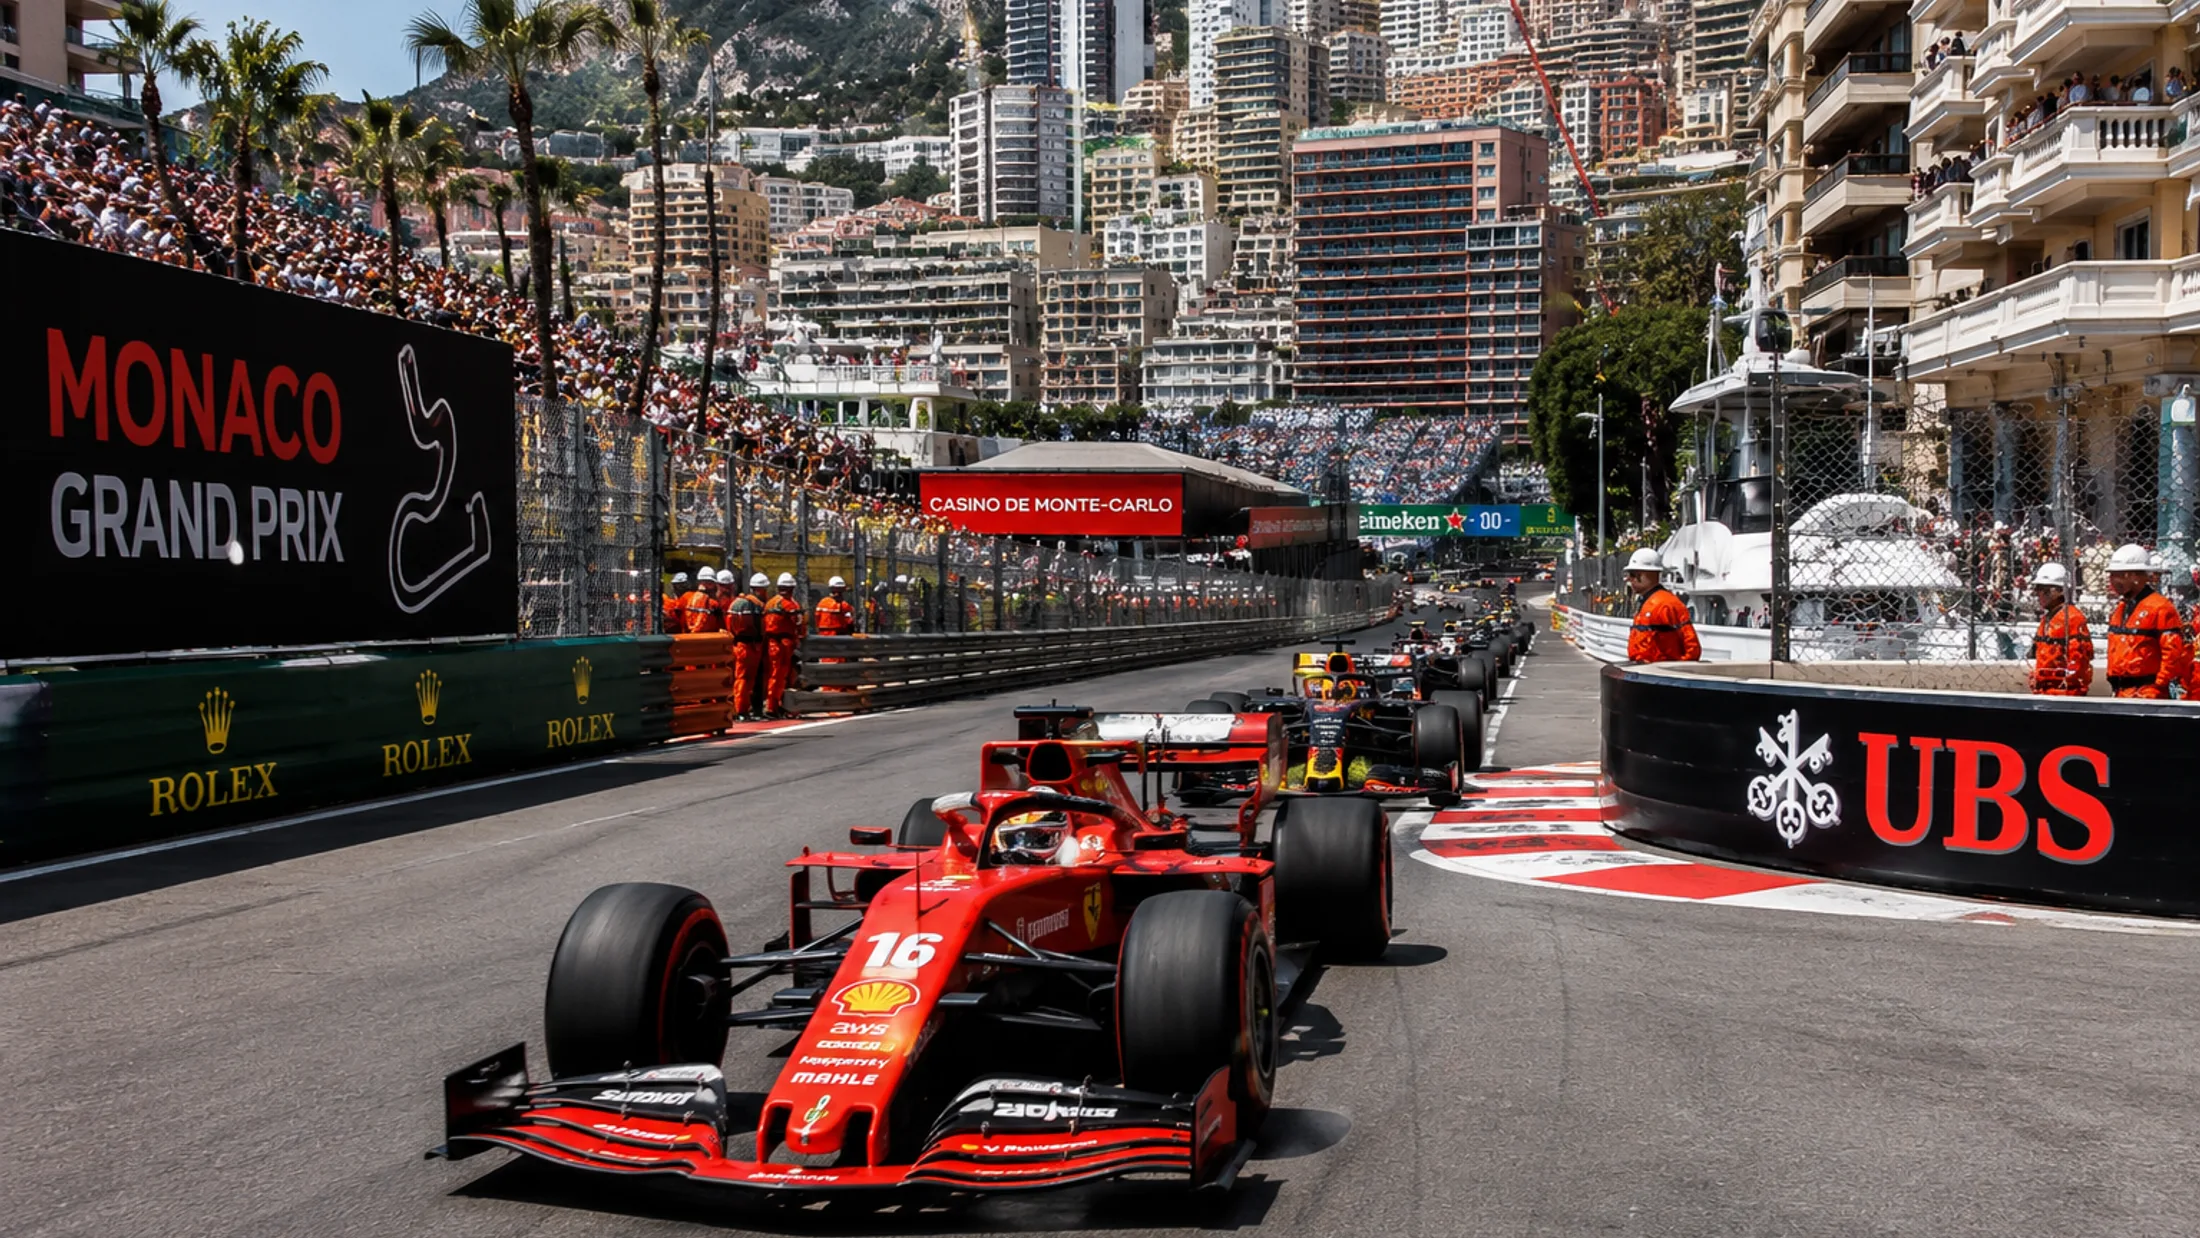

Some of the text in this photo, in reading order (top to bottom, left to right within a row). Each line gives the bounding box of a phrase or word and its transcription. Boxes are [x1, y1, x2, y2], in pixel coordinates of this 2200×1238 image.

[47, 328, 342, 464] MONACO
[51, 471, 345, 562] GRAND PRIX
[929, 497, 1173, 512] CASINO DE MONTE-CARLO
[546, 713, 616, 748] ROLEX
[382, 733, 471, 777] ROLEX
[149, 762, 278, 817] ROLEX
[1858, 731, 2114, 864] UBS
[865, 932, 944, 969] 16
[829, 1022, 890, 1036] aws
[790, 1071, 879, 1086] MAHLE
